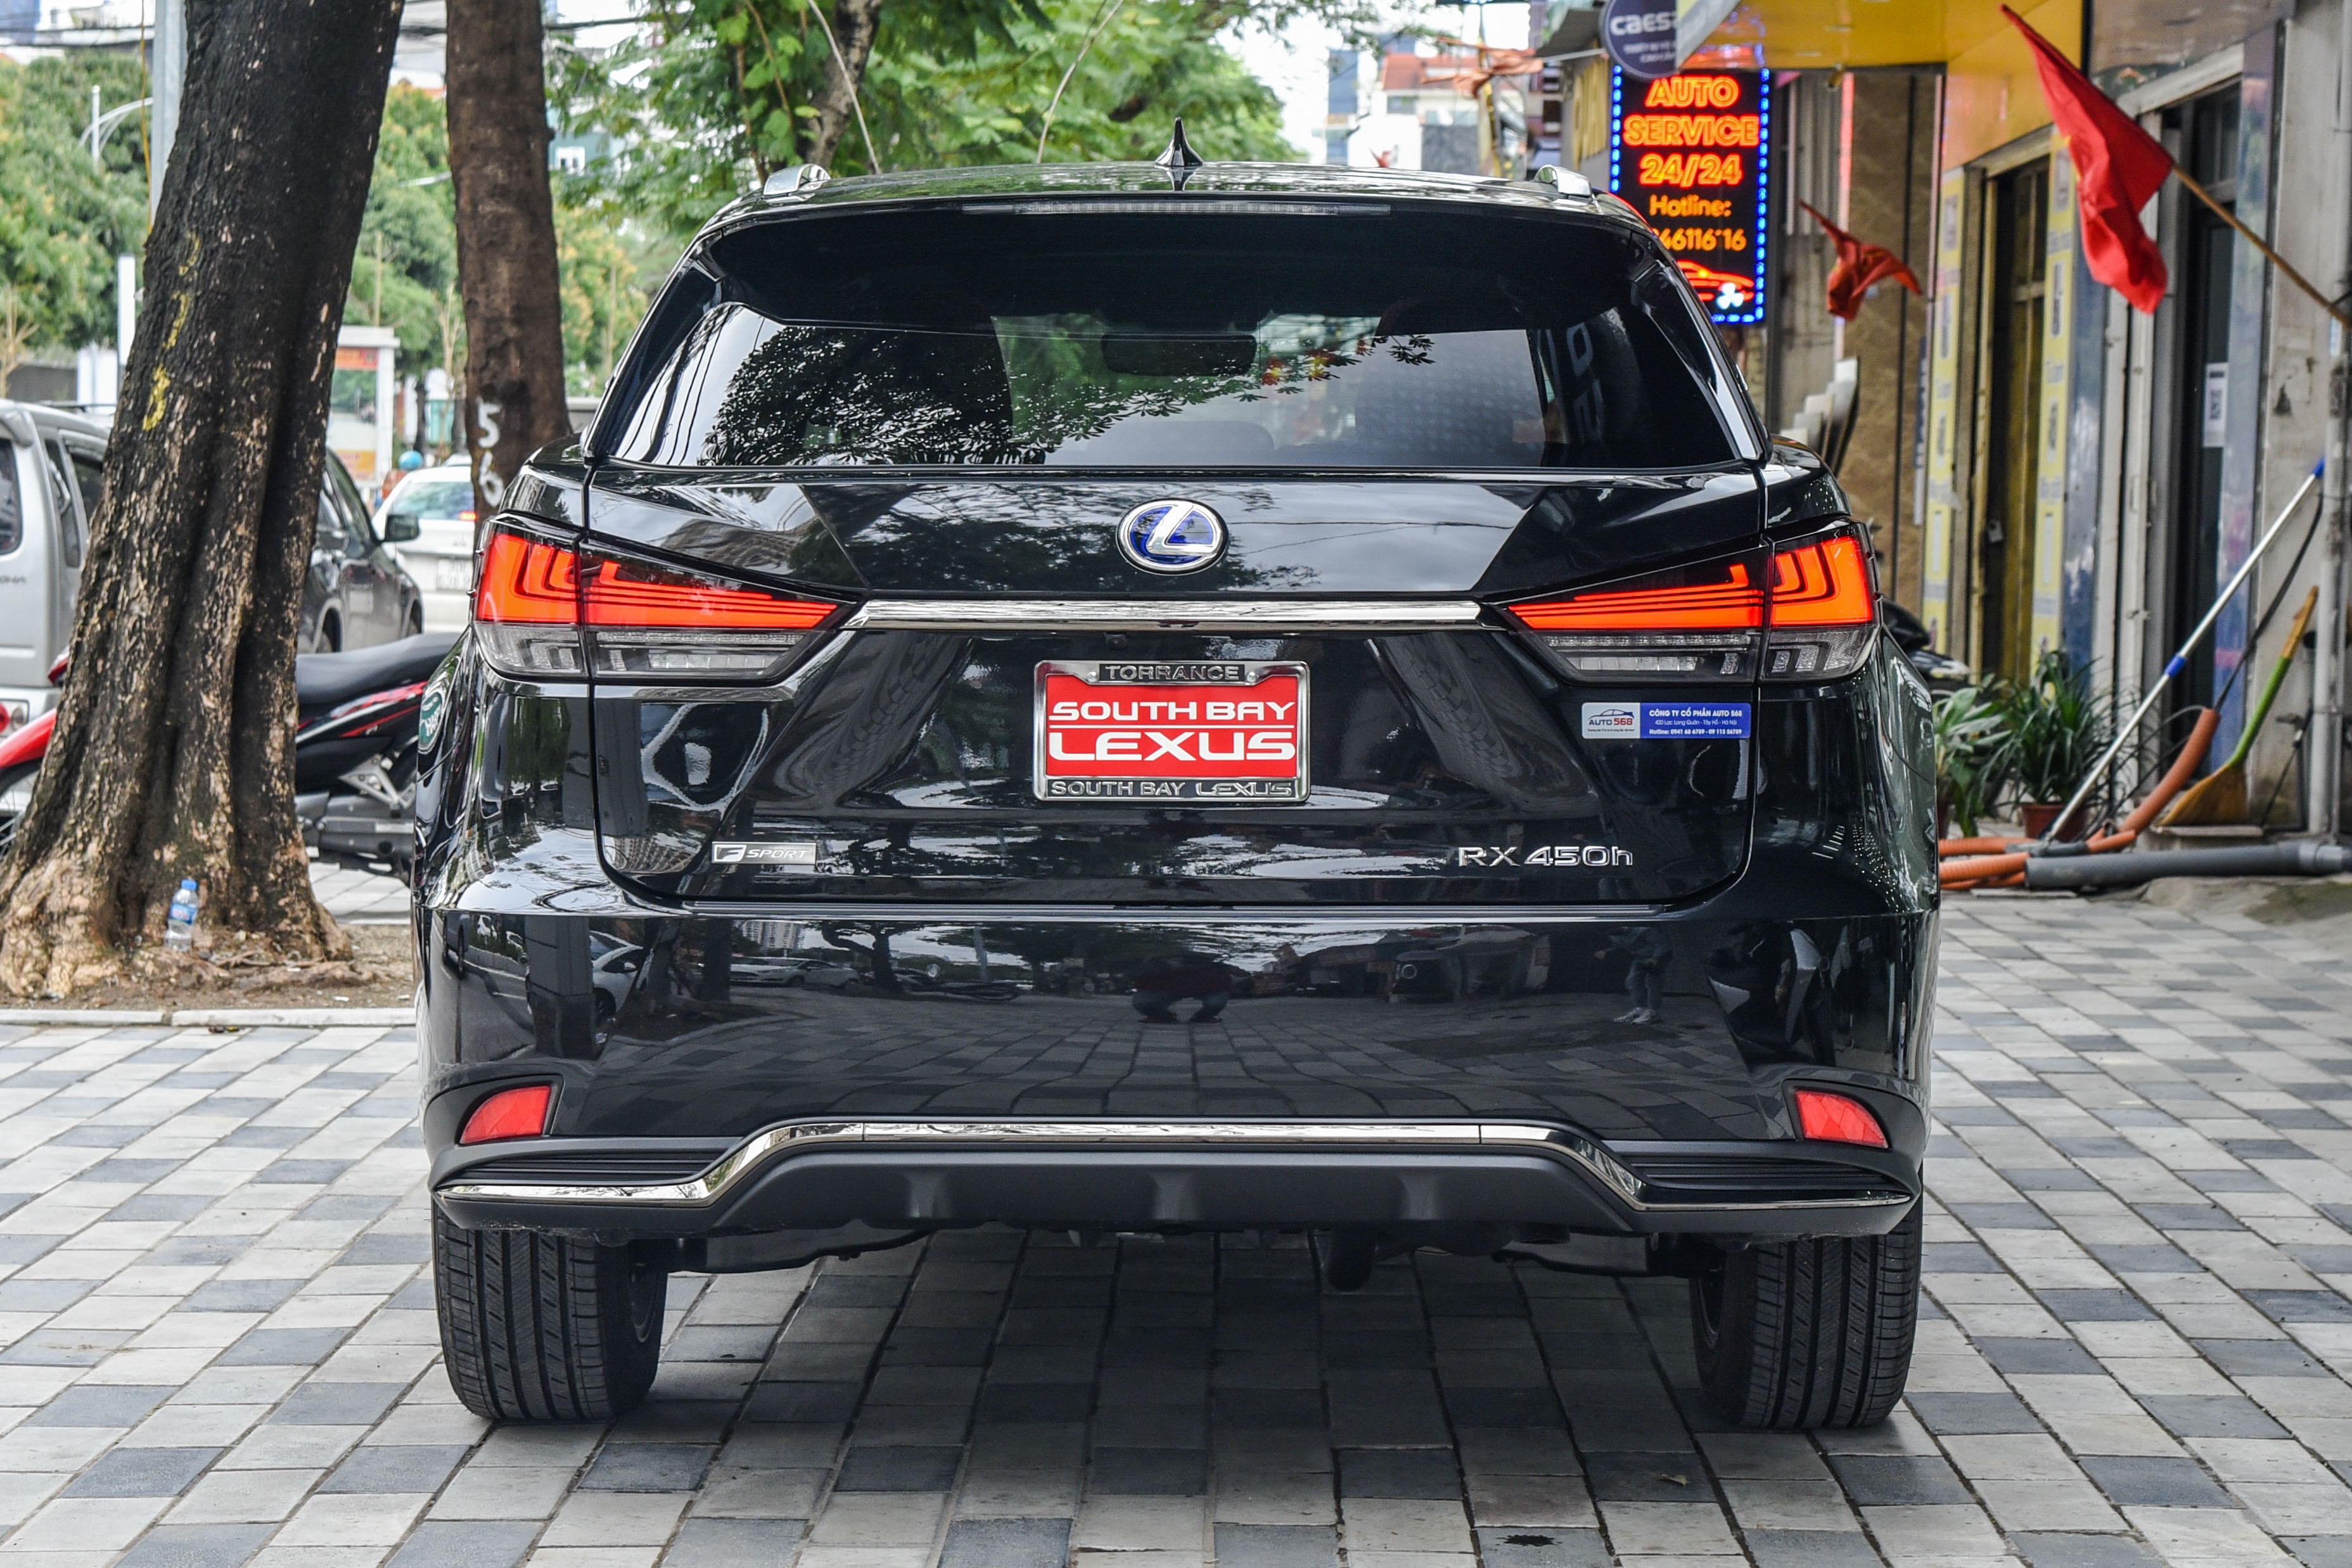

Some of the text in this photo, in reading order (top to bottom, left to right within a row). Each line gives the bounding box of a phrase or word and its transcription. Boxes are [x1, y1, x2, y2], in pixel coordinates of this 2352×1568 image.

[1645, 75, 1741, 108] AUTO
[1623, 114, 1760, 147] SERVICE
[1639, 153, 1742, 188] 24/24
[1649, 194, 1732, 217] Hotline:
[1104, 665, 1239, 680] TORRANCE
[1049, 701, 1295, 721] SOUTH BAY
[1613, 718, 1633, 726] 568
[1049, 732, 1296, 761] LEXUS
[1051, 781, 1292, 797] SOUTH BAY LEXUS
[746, 849, 810, 858] SPORT
[1458, 846, 1633, 867] RX 450h
